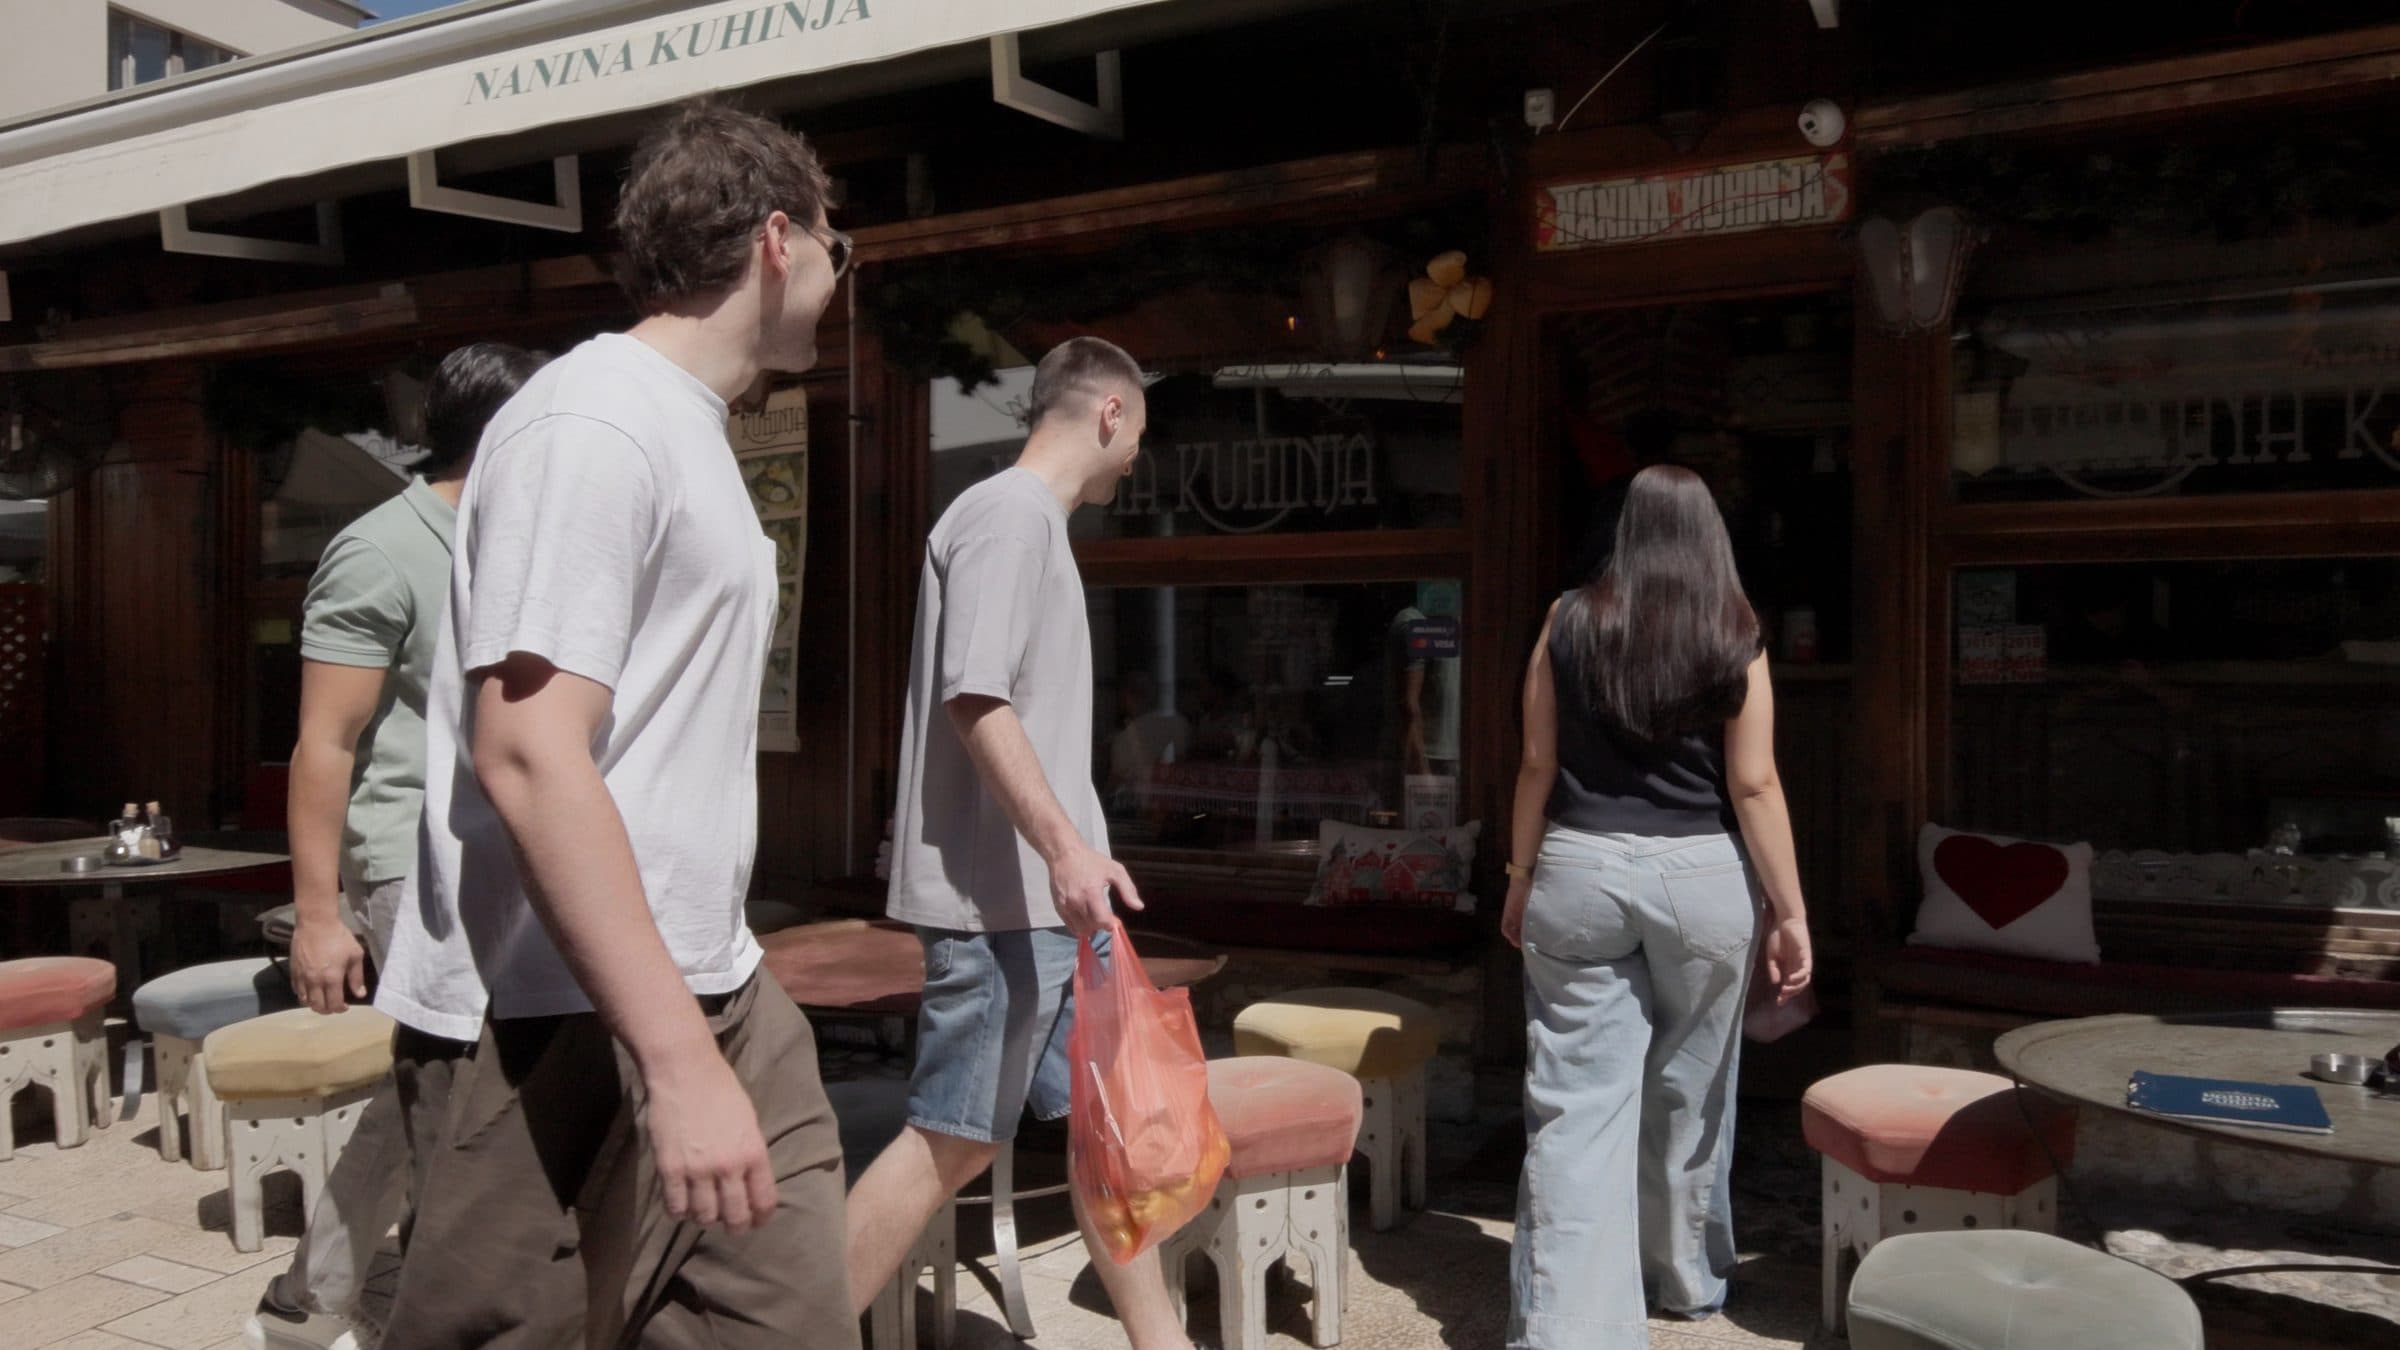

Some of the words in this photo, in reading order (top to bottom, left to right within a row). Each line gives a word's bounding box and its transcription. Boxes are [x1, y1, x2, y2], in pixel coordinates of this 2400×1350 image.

[464, 39, 634, 105] NANINA
[648, 0, 872, 66] KUHINJA
[1556, 178, 1670, 245] NANINA
[1681, 162, 1826, 232] KUHINJA
[1173, 432, 1379, 520] KUHINJA
